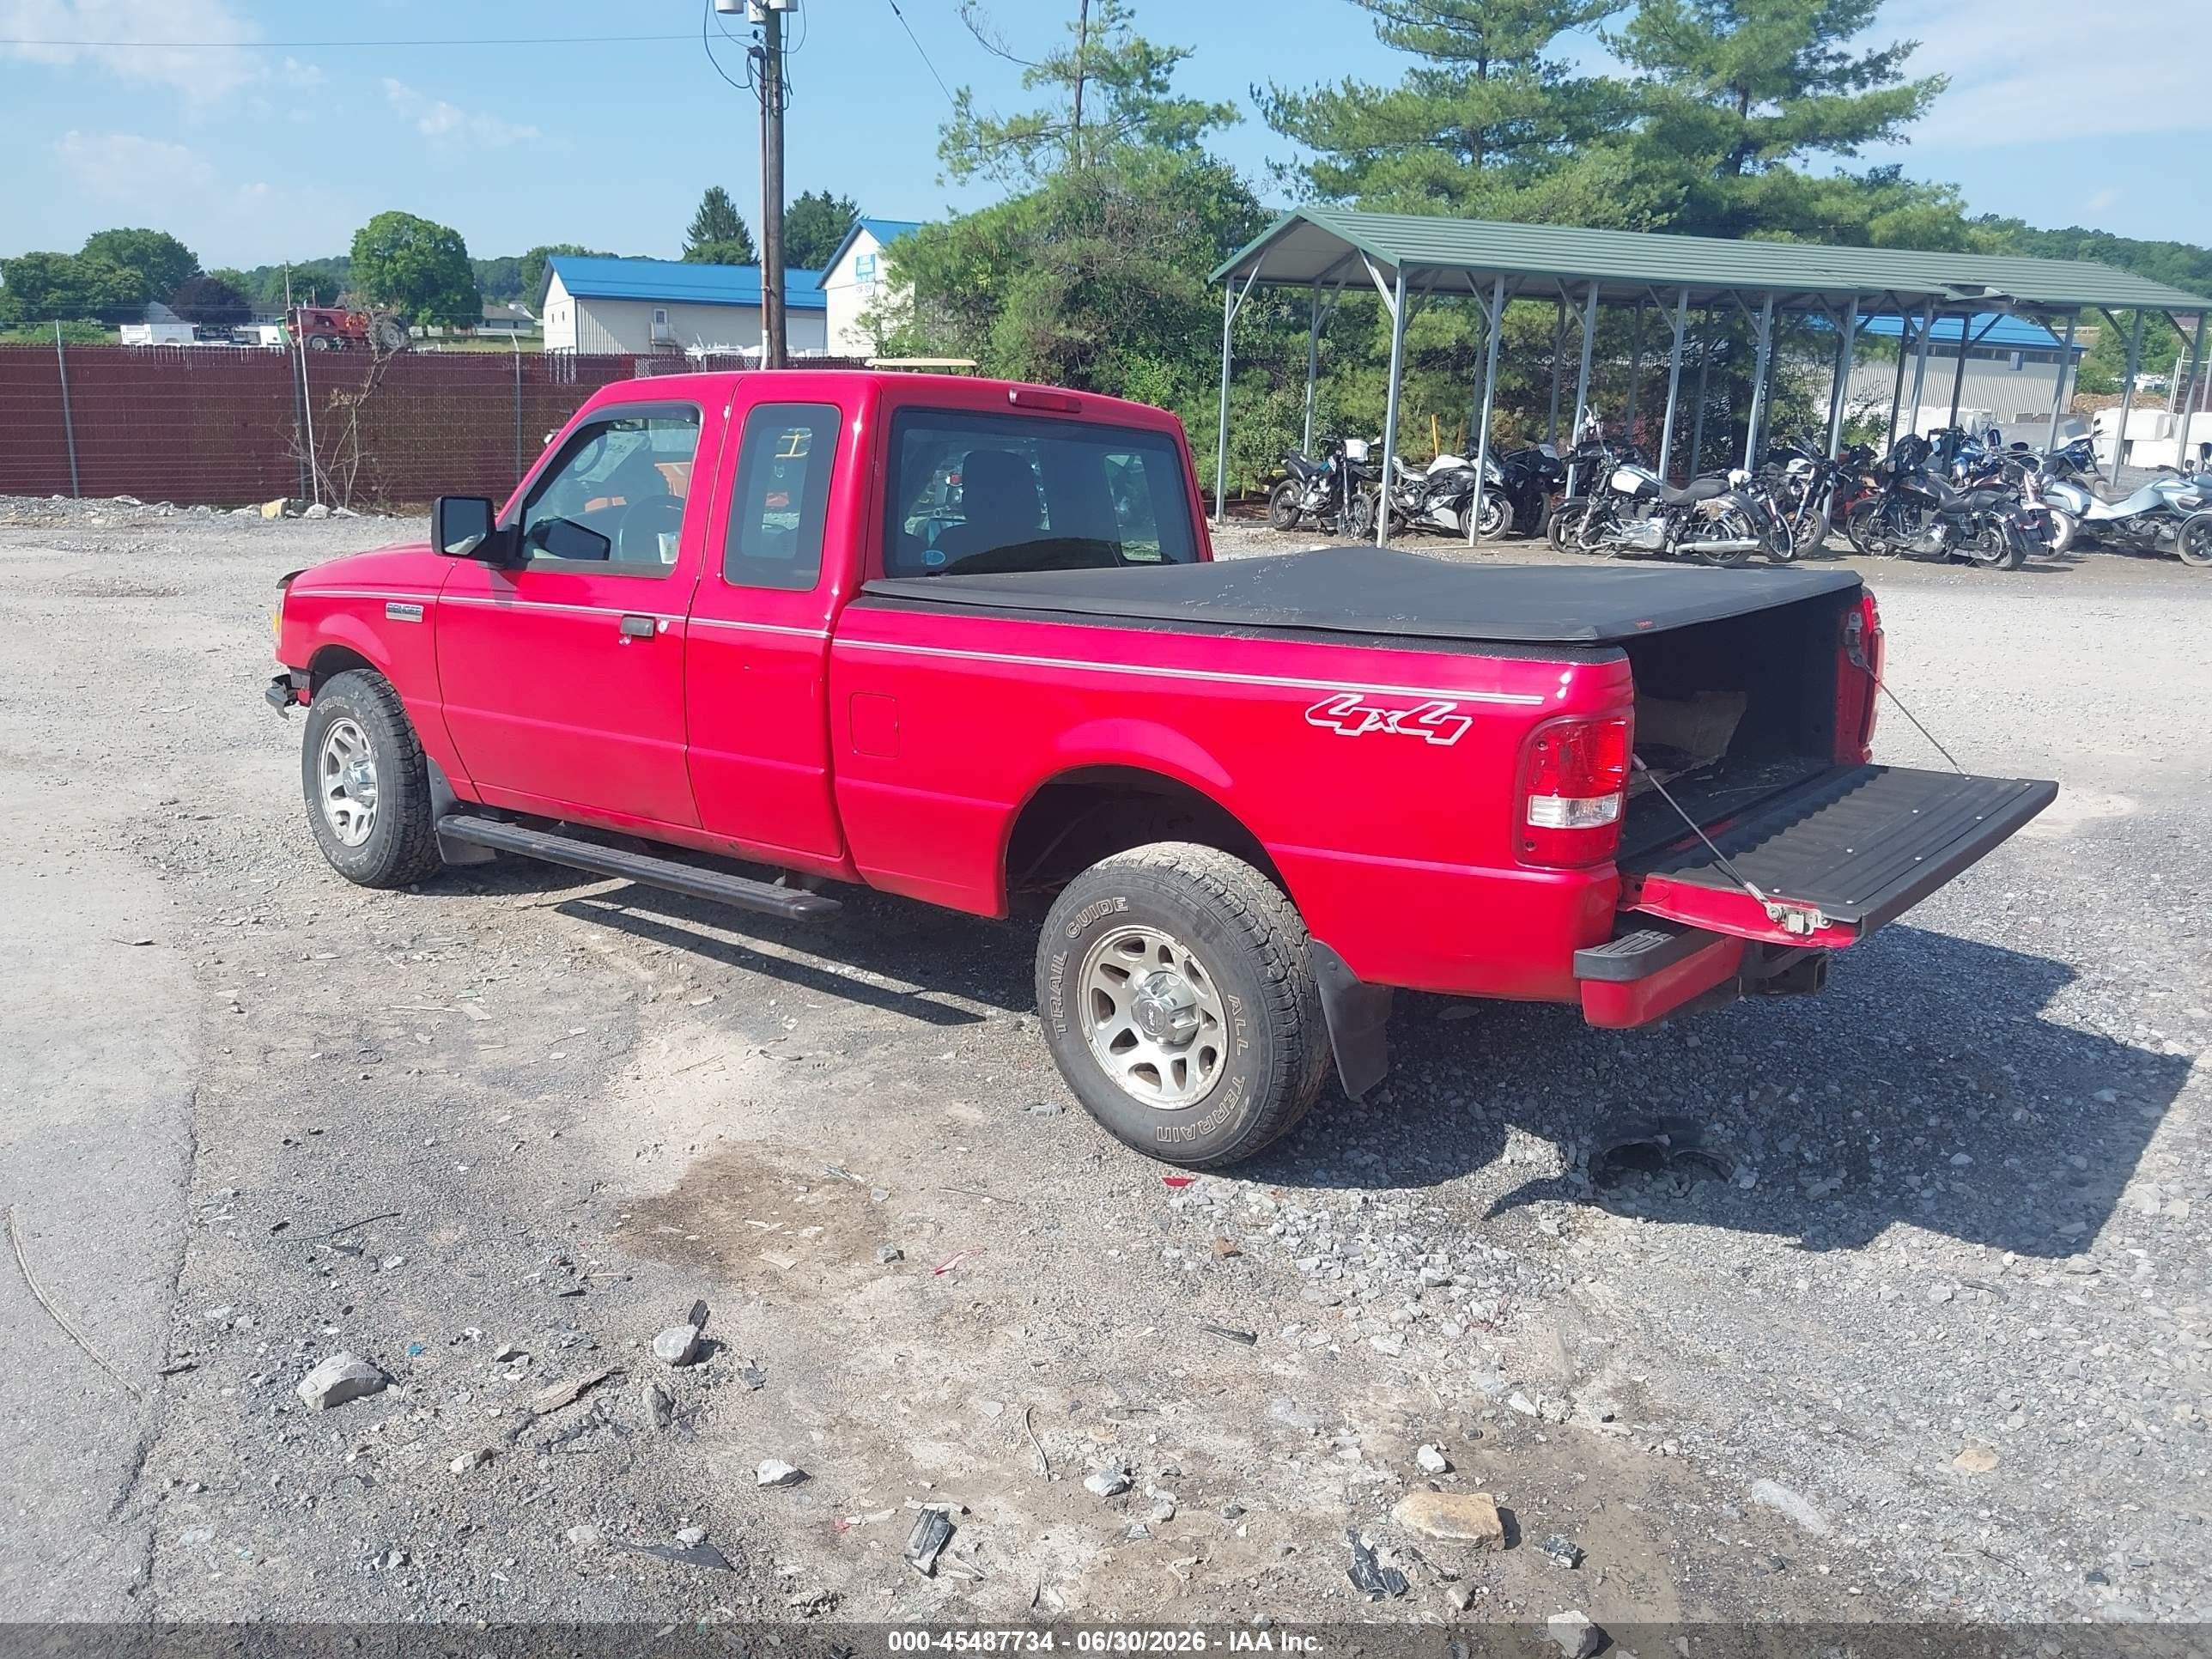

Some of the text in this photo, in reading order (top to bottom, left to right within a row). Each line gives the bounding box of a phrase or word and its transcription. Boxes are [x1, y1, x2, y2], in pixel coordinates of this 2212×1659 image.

[1304, 692, 1474, 746] 4x4
[1049, 896, 1130, 1039] TRAIL GUIDE
[1156, 994, 1250, 1144] ALL TERRAIN
